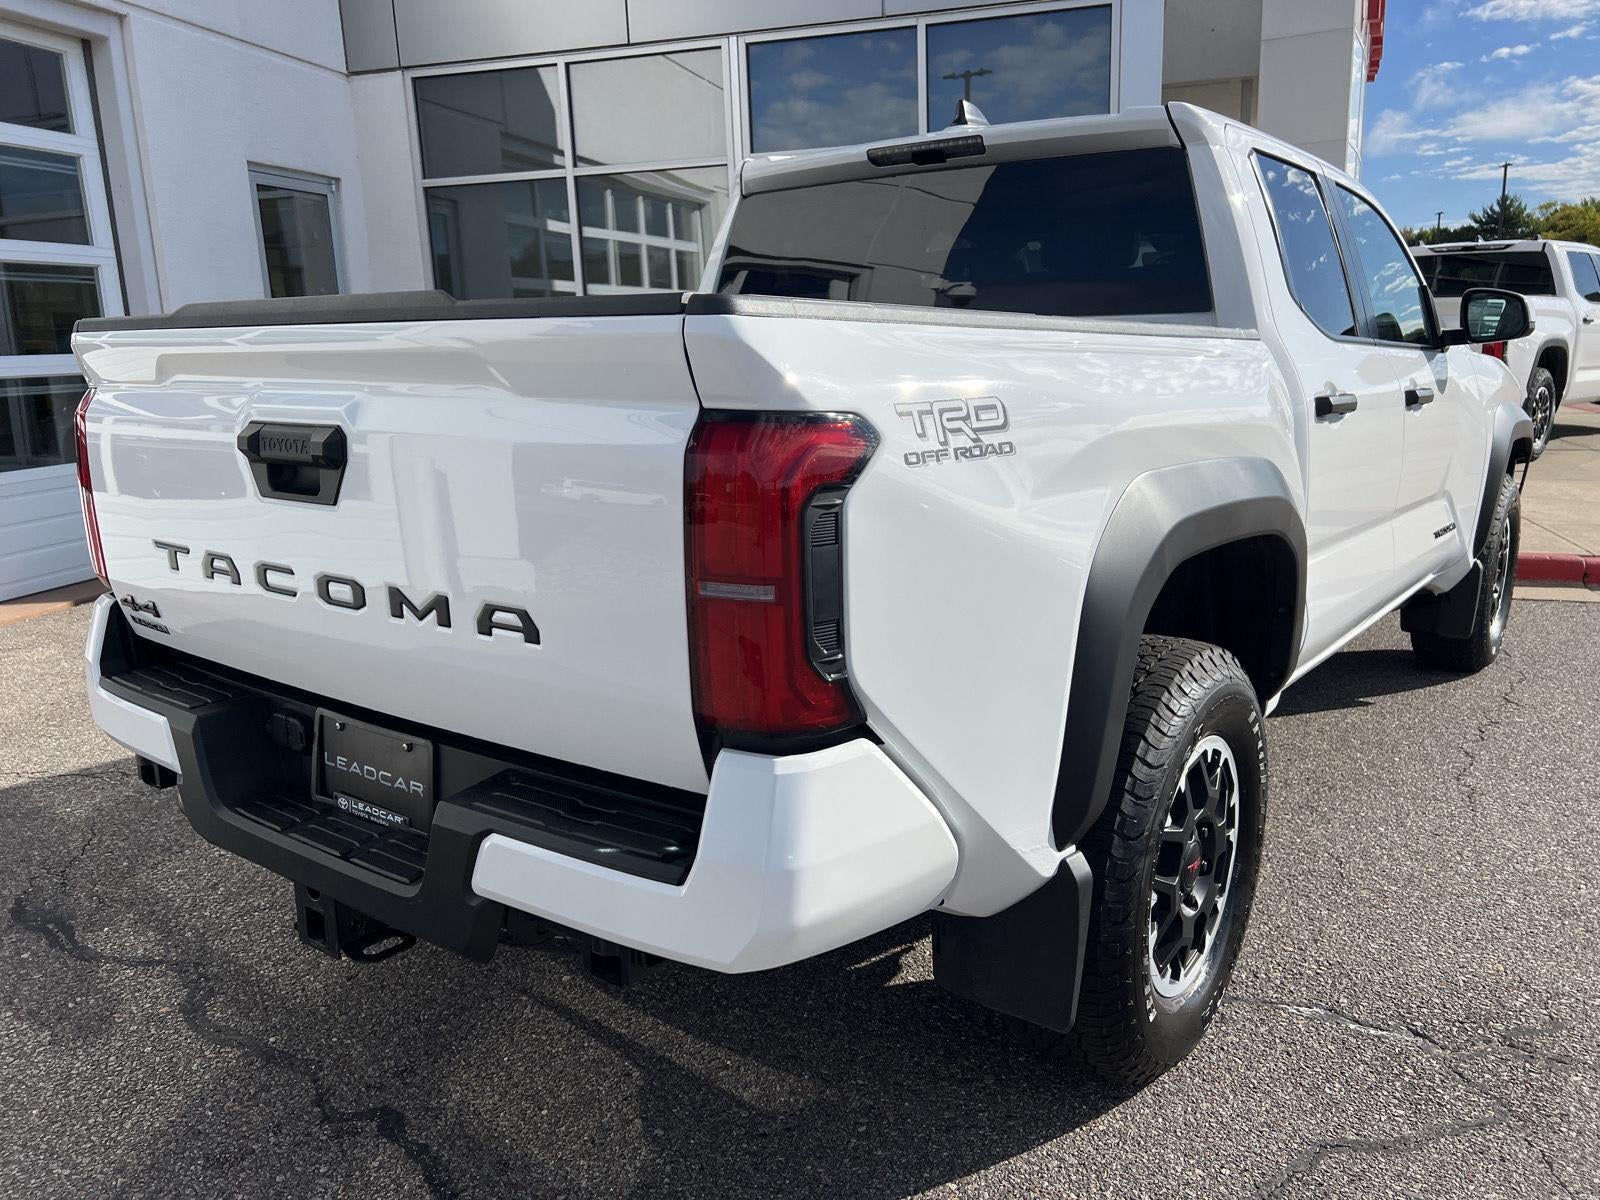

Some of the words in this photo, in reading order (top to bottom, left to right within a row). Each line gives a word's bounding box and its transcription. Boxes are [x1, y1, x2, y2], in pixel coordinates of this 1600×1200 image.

[893, 396, 1010, 447] TRD
[261, 436, 312, 455] TOYOTA
[903, 448, 950, 467] OFF
[953, 441, 1016, 462] ROAD
[152, 539, 542, 646] TACOMA
[324, 751, 424, 798] LEADCAR
[351, 799, 403, 824] LEADCAR
